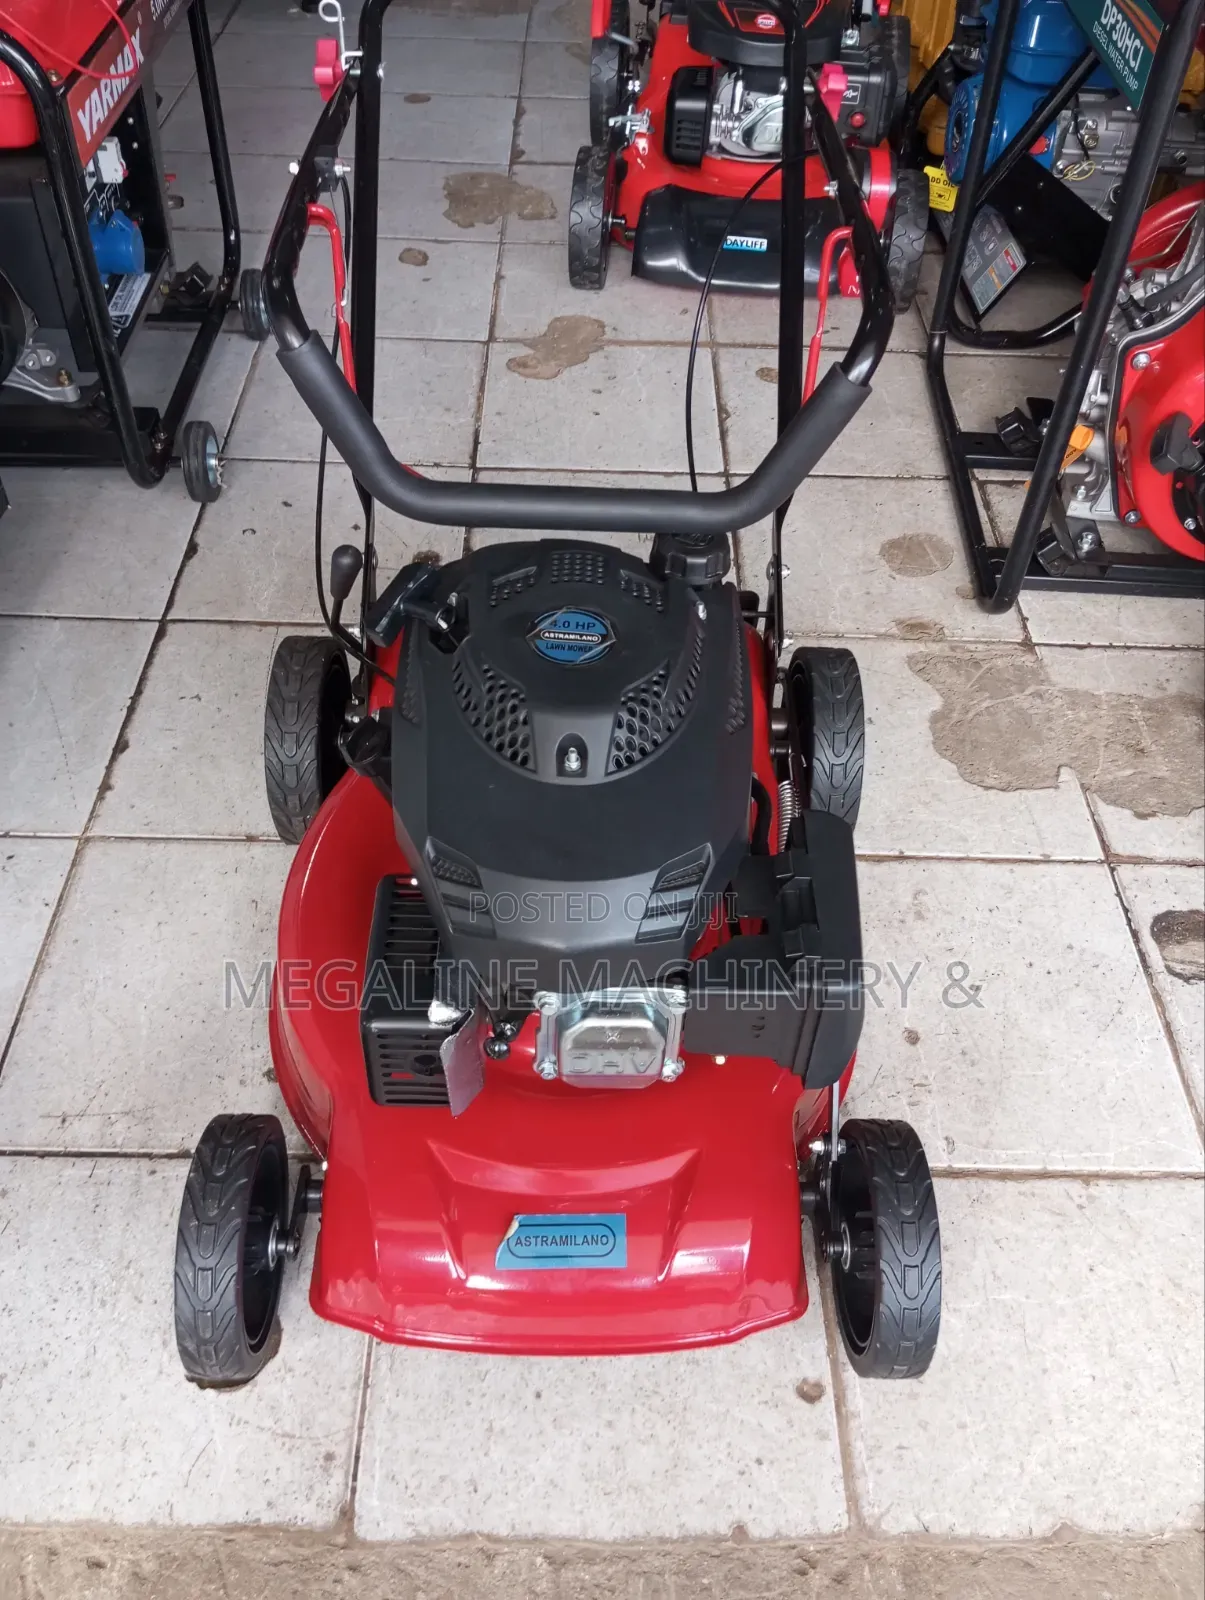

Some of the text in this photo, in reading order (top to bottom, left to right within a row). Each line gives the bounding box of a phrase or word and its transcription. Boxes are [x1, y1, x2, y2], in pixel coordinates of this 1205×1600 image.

[1093, 21, 1139, 91] DIESEL WATER PUMP
[726, 238, 765, 249] DAYLIFF
[576, 621, 596, 630] HP
[543, 632, 599, 642] ASTRAMILANO
[545, 642, 593, 653] LAWN MOWER
[514, 1234, 610, 1248] ASTRAMILANO
